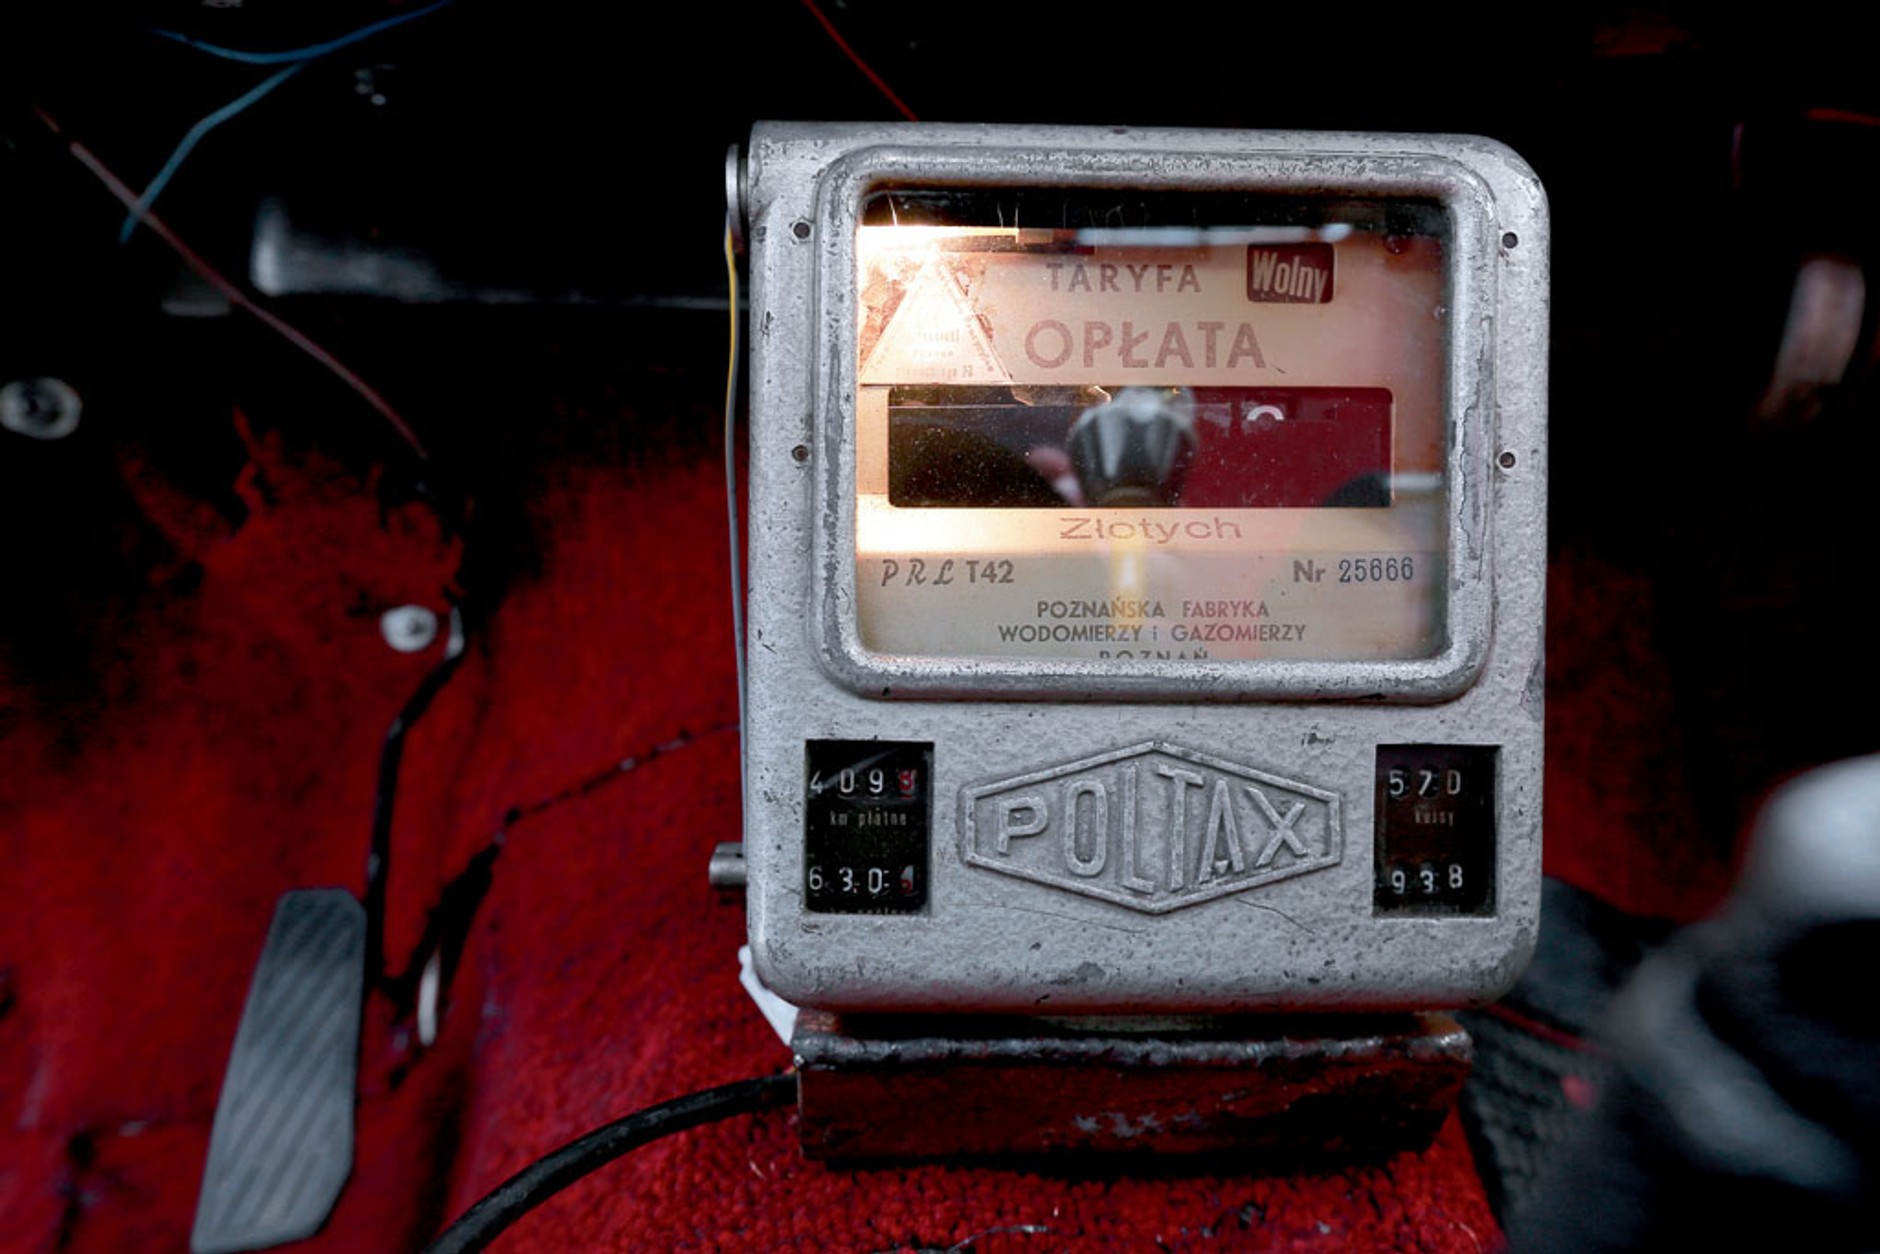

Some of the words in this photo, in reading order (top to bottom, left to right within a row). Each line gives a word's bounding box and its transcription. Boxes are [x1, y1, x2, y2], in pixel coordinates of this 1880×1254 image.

[1046, 263, 1202, 293] TARYFA
[1252, 249, 1328, 304] Wolny
[1024, 319, 1266, 369] OPŁATA
[1060, 517, 1242, 544] Złotych
[966, 560, 1015, 583] T42
[1293, 560, 1326, 583] Nr
[1338, 556, 1414, 583] 25666
[1037, 597, 1165, 619] POZNAŃSKA
[1182, 601, 1270, 619] FABRYKA
[998, 624, 1142, 642] WODOMIERZY
[1171, 624, 1307, 643] GAZOMIERZY
[994, 761, 1307, 894] POLTAX
